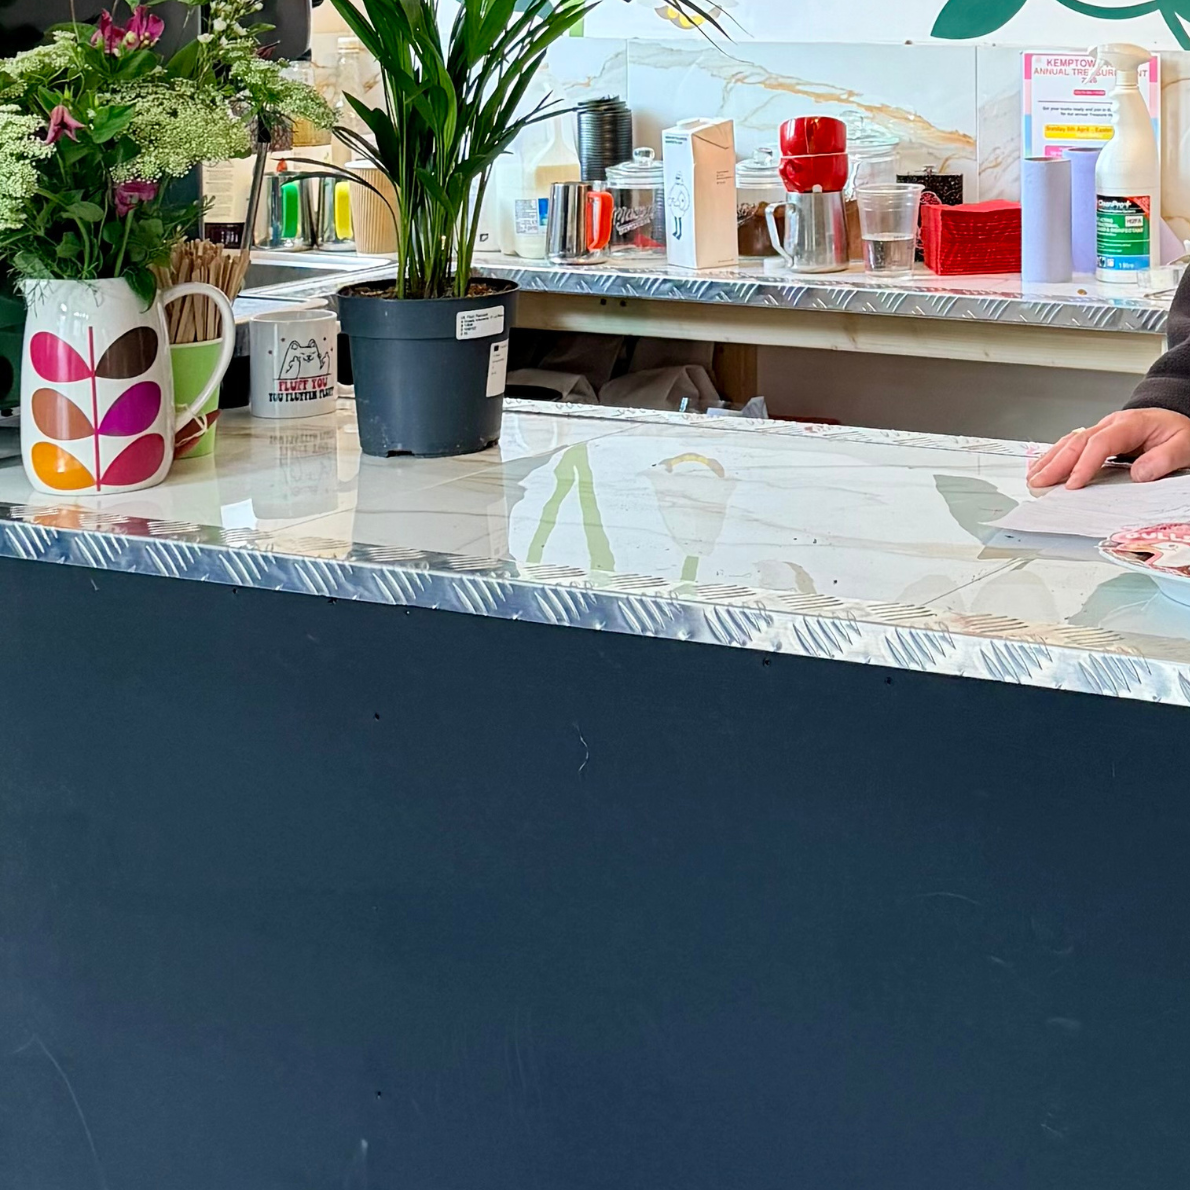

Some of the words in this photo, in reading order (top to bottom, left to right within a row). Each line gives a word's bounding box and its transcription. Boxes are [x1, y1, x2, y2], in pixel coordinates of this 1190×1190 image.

[1046, 58, 1097, 68] KEMPTOW
[1033, 68, 1069, 76] ANNUAL
[311, 377, 328, 390] YOU
